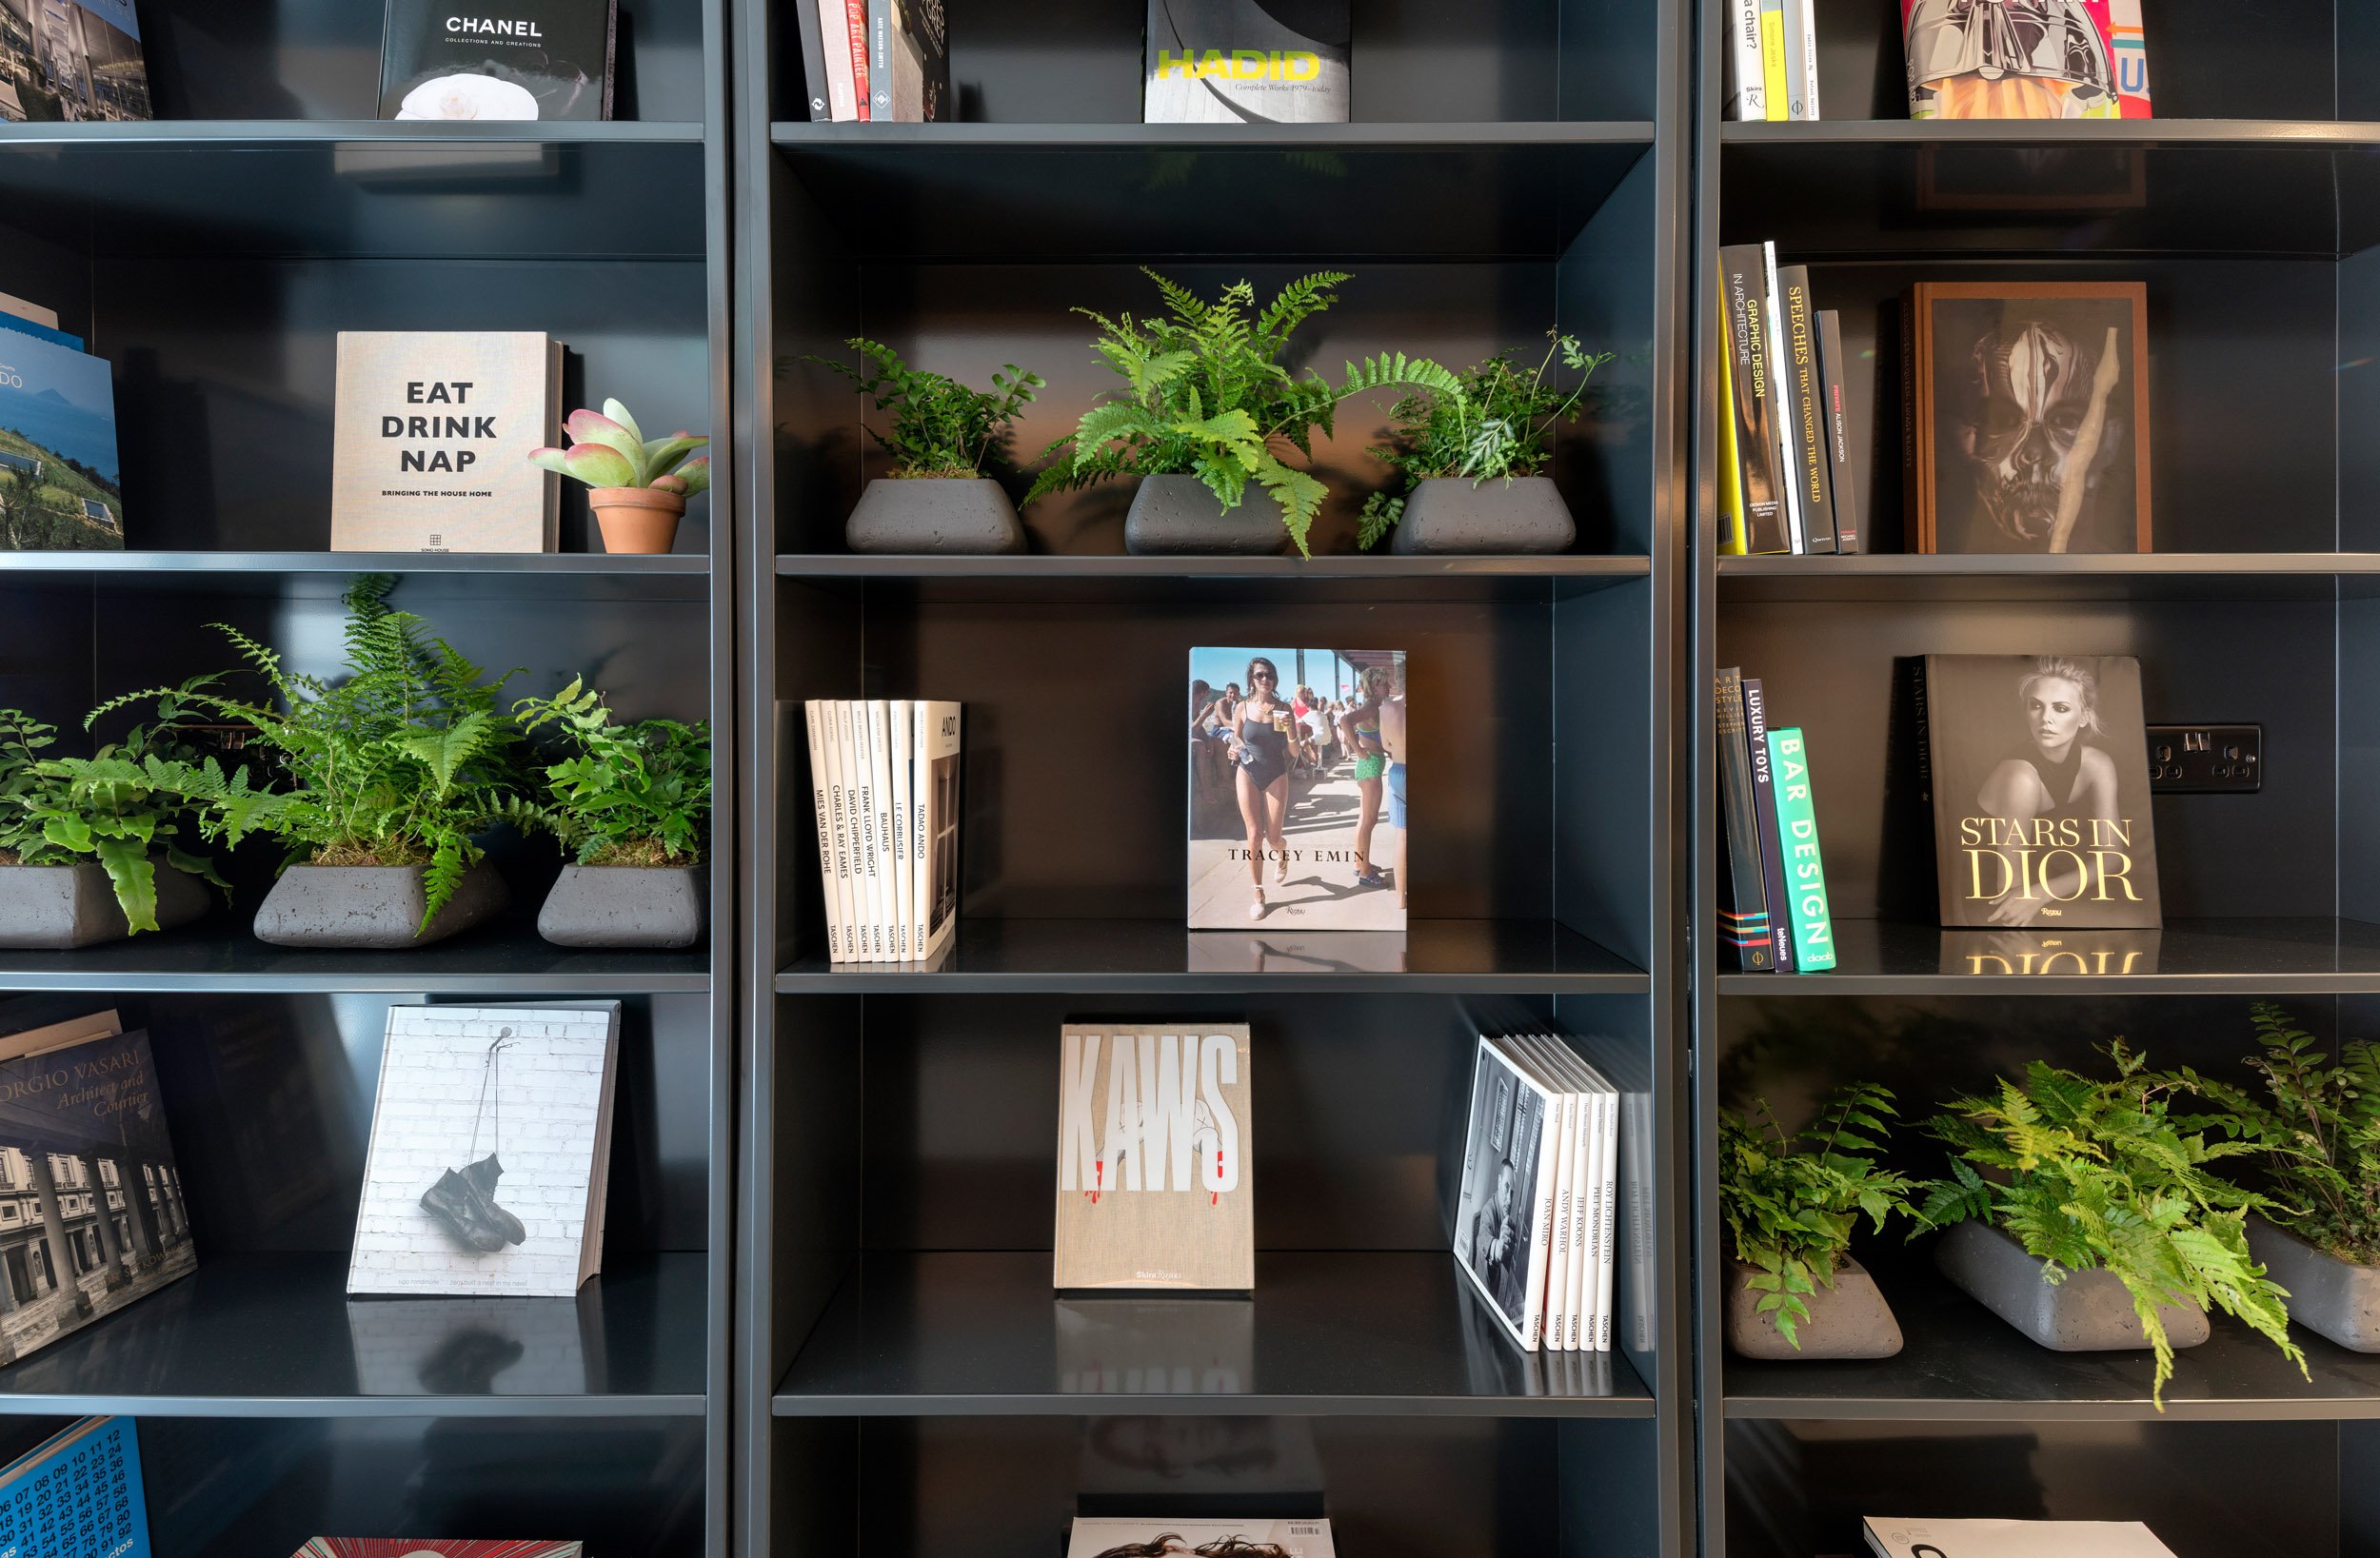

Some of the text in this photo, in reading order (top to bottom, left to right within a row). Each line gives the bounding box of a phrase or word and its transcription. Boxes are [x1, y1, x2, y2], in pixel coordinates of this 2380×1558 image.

[446, 16, 543, 37] CHANEL
[1744, 10, 1757, 49] chair?
[1158, 49, 1320, 81] HADID
[1235, 83, 1267, 92] Complete
[1733, 273, 1751, 365] IN ARCHITECTURE
[1747, 299, 1765, 398] GRAPHIC DESIGN
[407, 382, 473, 404] EAT
[1789, 286, 1821, 503] SPEECHES THAT CHANGED THE WORLD
[382, 416, 497, 439] DRINK
[1835, 412, 1843, 434] ALISON
[401, 450, 476, 473] NAP
[1715, 675, 1740, 684] ART
[1715, 685, 1741, 695] DECO
[1716, 694, 1742, 704] STYLE
[942, 716, 957, 738] ANDO
[1748, 689, 1769, 783] LUXURY TOYS
[832, 784, 843, 822] CHARLES
[816, 789, 831, 874] MIES VAN DER ROHE
[838, 833, 846, 849] RAY
[847, 789, 863, 875] DAVID CHIPPERFIELD
[862, 785, 876, 878] FRANK LLOYD WRIGHT
[880, 812, 890, 852] BAUHAUS
[895, 814, 903, 860] CORBUSIER
[917, 803, 925, 859] TADAO ANDO
[1780, 738, 1829, 944] BAR DESIGN
[1960, 818, 2132, 847] STARS IN
[839, 851, 848, 878] EAMES
[1228, 848, 1365, 862] TRACEY EMIN
[1962, 849, 2143, 901] DIOR
[830, 924, 839, 954] TASCHEN
[845, 924, 854, 954] TASCHEN
[860, 924, 868, 953] TASCHEN
[873, 924, 882, 954] TASCHEN
[1776, 927, 1787, 961] teNeues
[1807, 951, 1834, 963] daab
[74, 1051, 139, 1079] VASARI
[57, 1071, 144, 1110] Architect and
[94, 1092, 149, 1117] Courtier
[1061, 1035, 1239, 1193] KAWS
[1543, 1197, 1553, 1222] JOAN
[1558, 1189, 1570, 1255] ANDY WARHOL
[1576, 1196, 1585, 1247] JEFF KOONS
[1603, 1180, 1614, 1264] ROY LICHTENSTEIN
[15, 1430, 120, 1504] 07 08 09 10 11 12
[17, 1443, 122, 1518] 19 20 21 22 23 24
[19, 1456, 124, 1533] 31 32 33 34 35 36
[21, 1469, 126, 1547] 41 42 43 44 45 46
